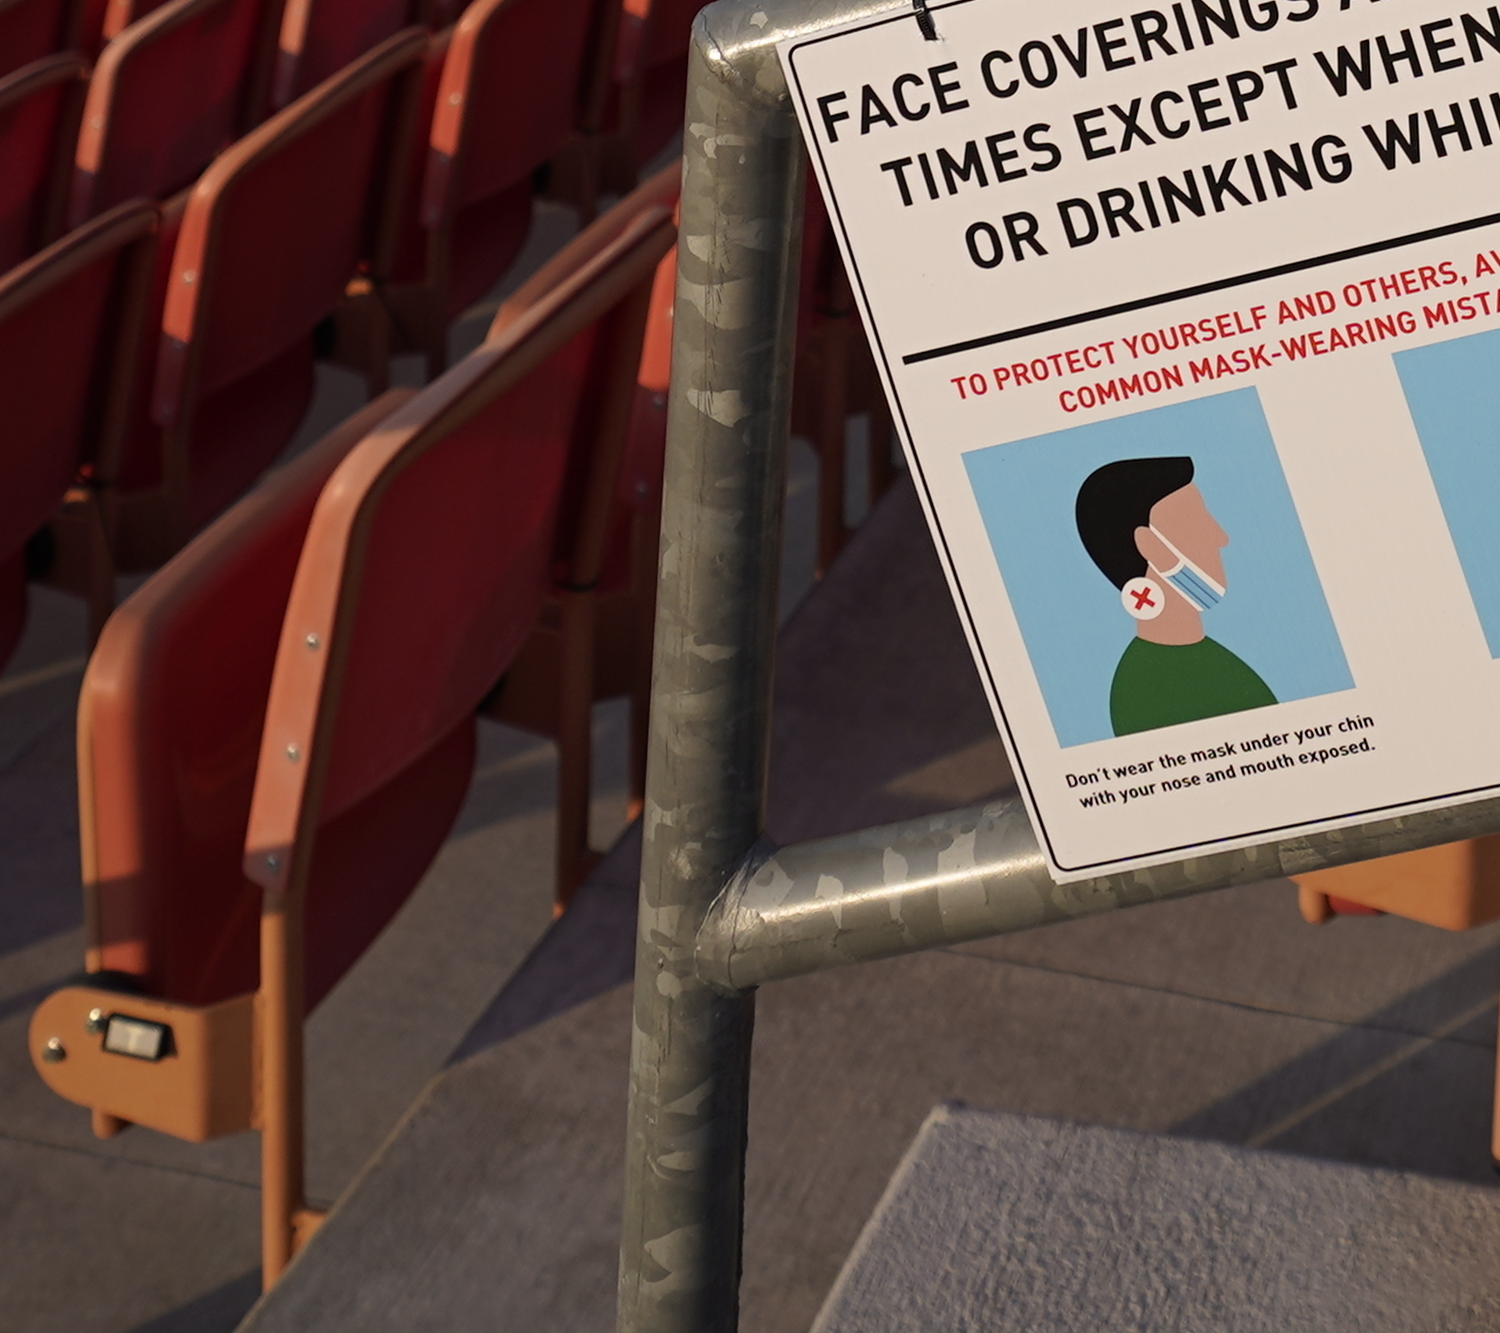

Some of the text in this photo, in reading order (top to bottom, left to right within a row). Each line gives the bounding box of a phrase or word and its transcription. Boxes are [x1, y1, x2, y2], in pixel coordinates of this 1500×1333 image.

[815, 60, 970, 144] FACE
[878, 121, 1062, 207] TIMES
[1072, 56, 1298, 161] EXCEPT
[964, 210, 1049, 270] OR
[1055, 133, 1353, 249] DRINKING
[949, 372, 988, 399] TO
[992, 340, 1115, 391] PROTECT
[1121, 304, 1267, 359] YOURSELF
[1277, 289, 1336, 325] AND
[1341, 260, 1468, 307] OTHERS,
[1058, 363, 1184, 413] COMMON
[1187, 310, 1417, 383] MASK-WEARING
[1064, 714, 1374, 788] Don't wear the mask under your chin
[1078, 736, 1376, 808] with your nose and mouth exposed.
